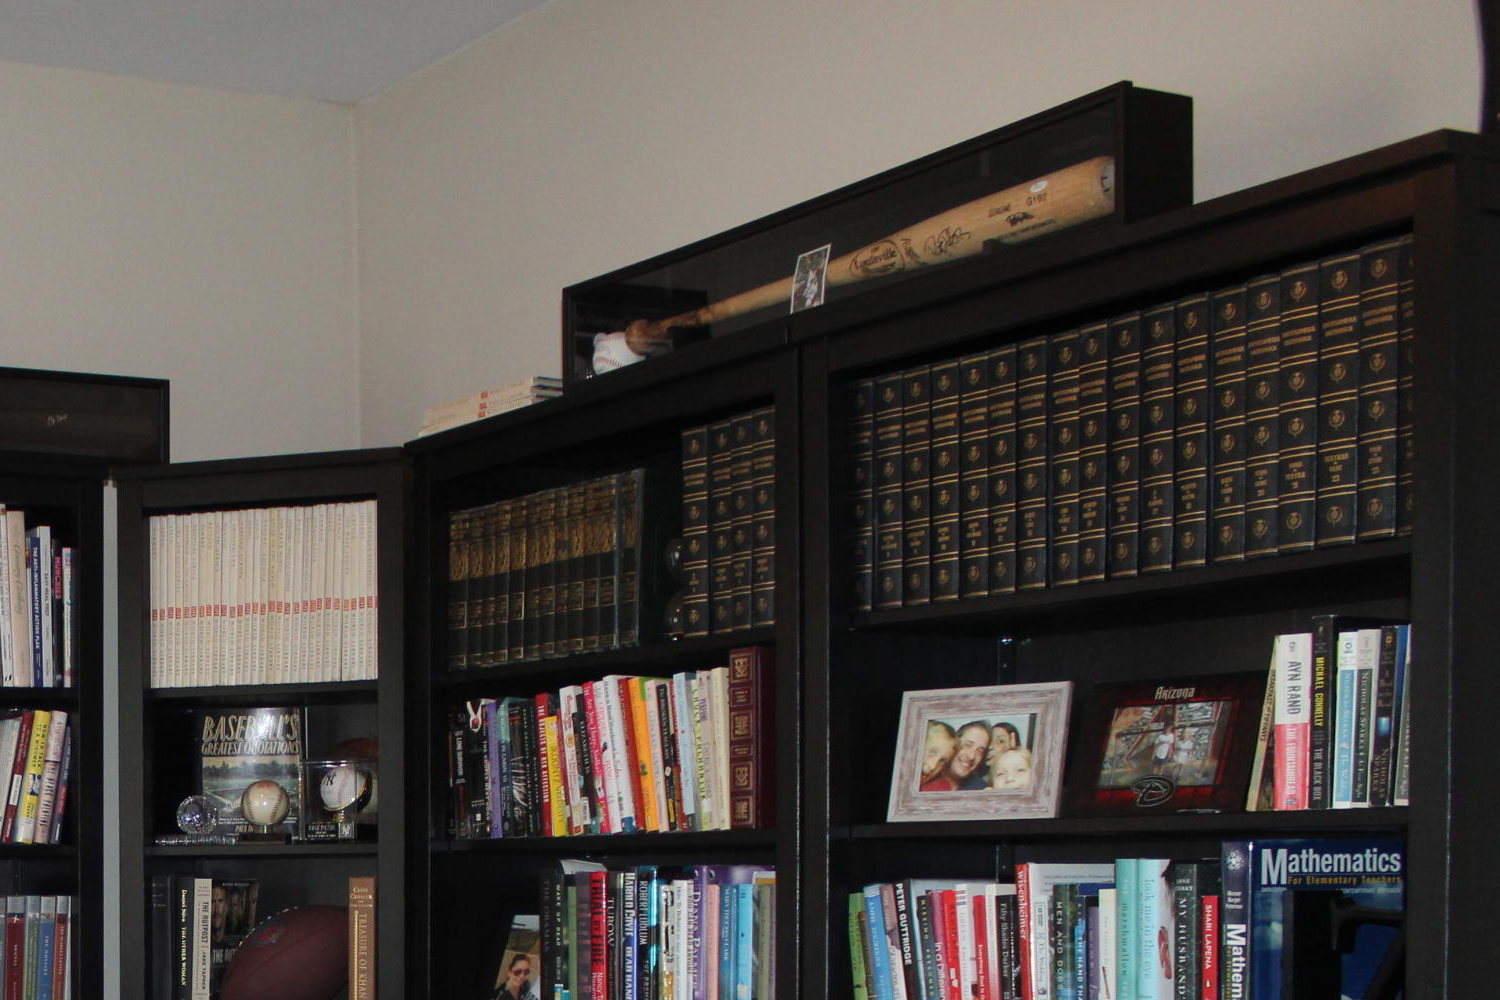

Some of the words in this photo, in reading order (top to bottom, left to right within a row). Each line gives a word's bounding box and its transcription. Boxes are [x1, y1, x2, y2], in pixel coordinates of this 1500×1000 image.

[1286, 661, 1302, 681] AYN
[1315, 657, 1324, 689] MICHAEL
[1154, 685, 1195, 700] Arizona
[1286, 686, 1301, 715] RAND
[1359, 672, 1369, 715] NICHOLAS
[1314, 693, 1324, 726] CONNELLY
[1286, 727, 1296, 740] THE
[1358, 717, 1368, 751] SPARKS
[201, 741, 243, 755] GREATEST
[244, 740, 299, 755] QUOTATIONS
[1314, 748, 1323, 760] THE
[1313, 762, 1323, 785] BLACK
[1371, 755, 1380, 792] SPARKS
[1379, 748, 1389, 799] NICHOLAS
[1313, 786, 1323, 801] BOX
[1261, 848, 1402, 886] Mathematics
[625, 873, 635, 907] HAROLD
[1144, 879, 1154, 902] look
[1288, 876, 1302, 885] For
[1306, 876, 1357, 886] Elementary
[639, 881, 648, 914] ROBERT
[896, 883, 905, 912] PETER
[1178, 898, 1186, 919] MY
[1000, 903, 1008, 921] Fifty
[358, 913, 368, 956] TREASURE
[639, 915, 648, 945] LUDLUM
[899, 913, 912, 965] GUTTRIDGE
[1122, 903, 1130, 976] marshmallow
[625, 946, 634, 971] DEAD
[1145, 939, 1155, 957] the
[359, 959, 368, 971] OF
[358, 974, 367, 999] KHAN
